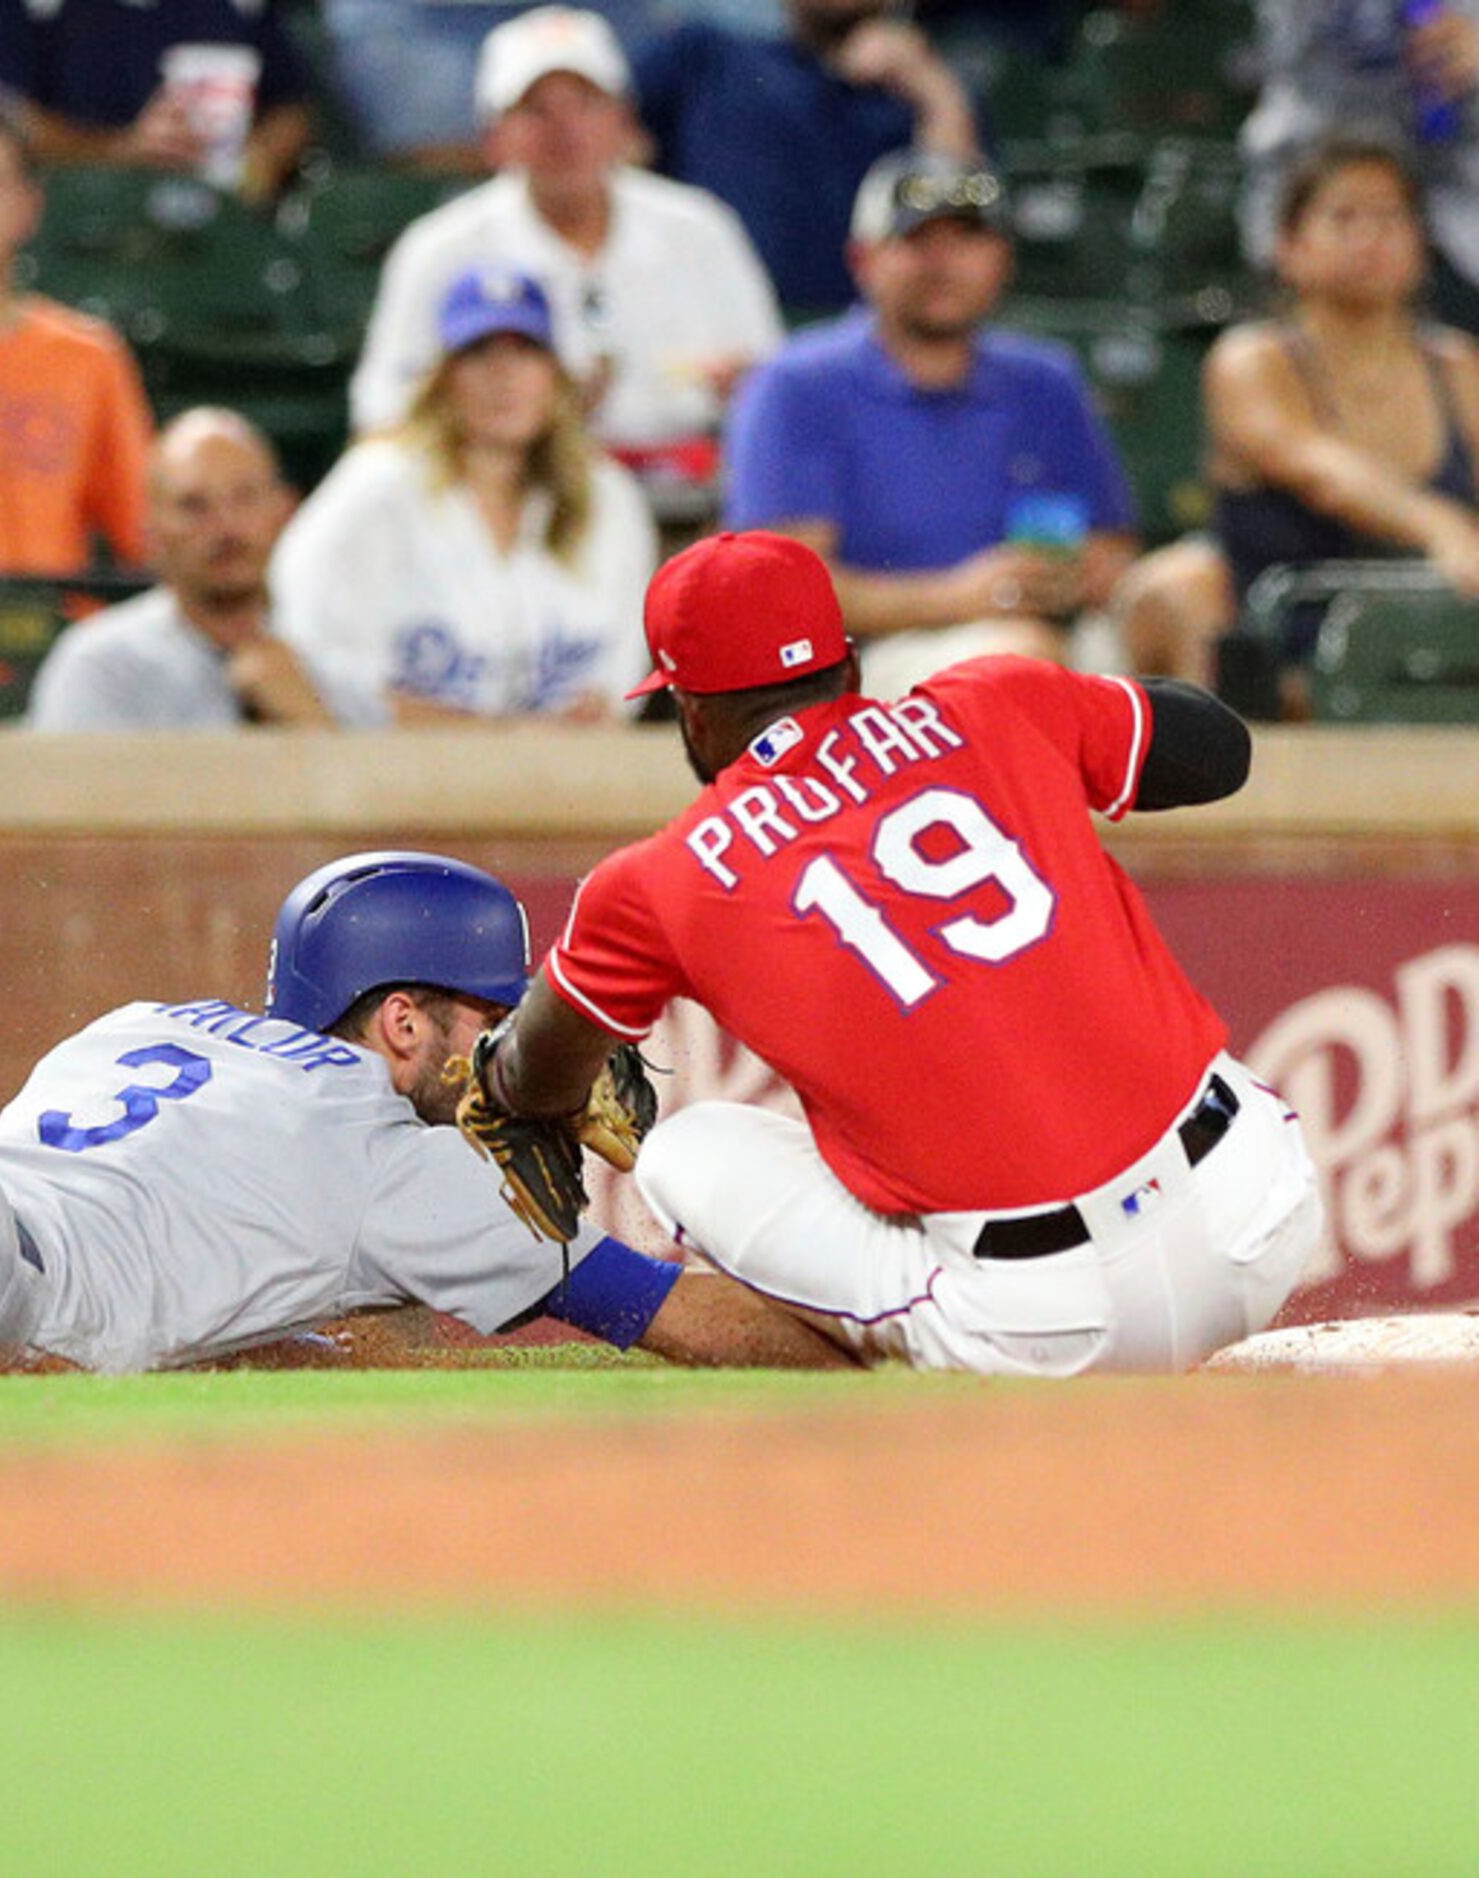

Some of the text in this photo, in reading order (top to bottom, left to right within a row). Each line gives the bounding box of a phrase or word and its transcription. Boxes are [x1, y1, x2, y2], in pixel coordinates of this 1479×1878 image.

[685, 696, 966, 893] PROFAR
[790, 784, 1059, 1018] 19
[38, 1042, 214, 1153] 3
